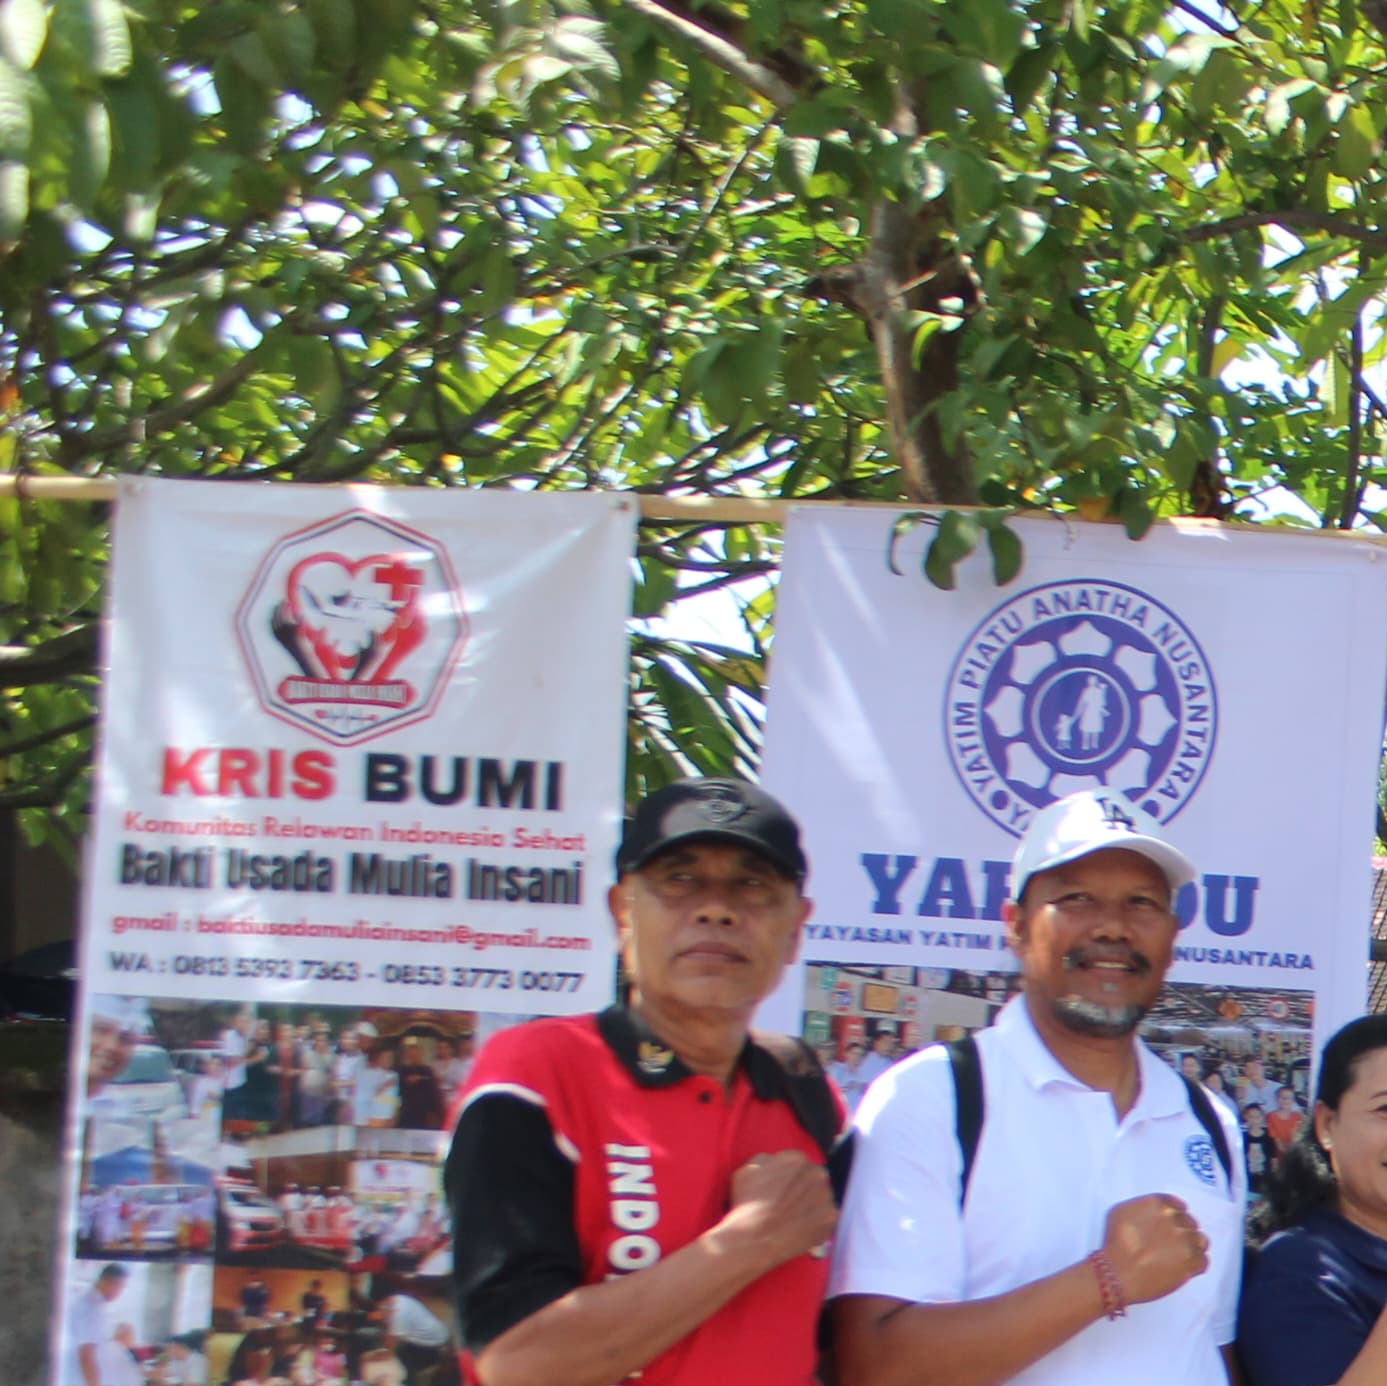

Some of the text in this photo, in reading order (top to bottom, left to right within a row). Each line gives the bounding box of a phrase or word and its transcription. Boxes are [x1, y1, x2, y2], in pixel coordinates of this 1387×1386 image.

[953, 588, 1210, 801] YATIM PIATU ANATHA NUSANTARA
[161, 747, 564, 811] KRIS BUMI
[124, 810, 586, 851] Komunitas Relawan Indonesia Sehat
[120, 843, 583, 905] Bakti Usada Mulia Insani
[112, 911, 178, 934] gmail
[804, 924, 912, 946] YAYASAN
[919, 930, 994, 950] YATIM
[1174, 945, 1315, 970] NUSANTARA
[110, 950, 152, 973] WA
[173, 954, 230, 977] 0813
[235, 956, 293, 979] 5393
[299, 958, 359, 982] 7363
[384, 963, 446, 986] 0853
[452, 966, 513, 990] 3773
[519, 970, 585, 993] 0077
